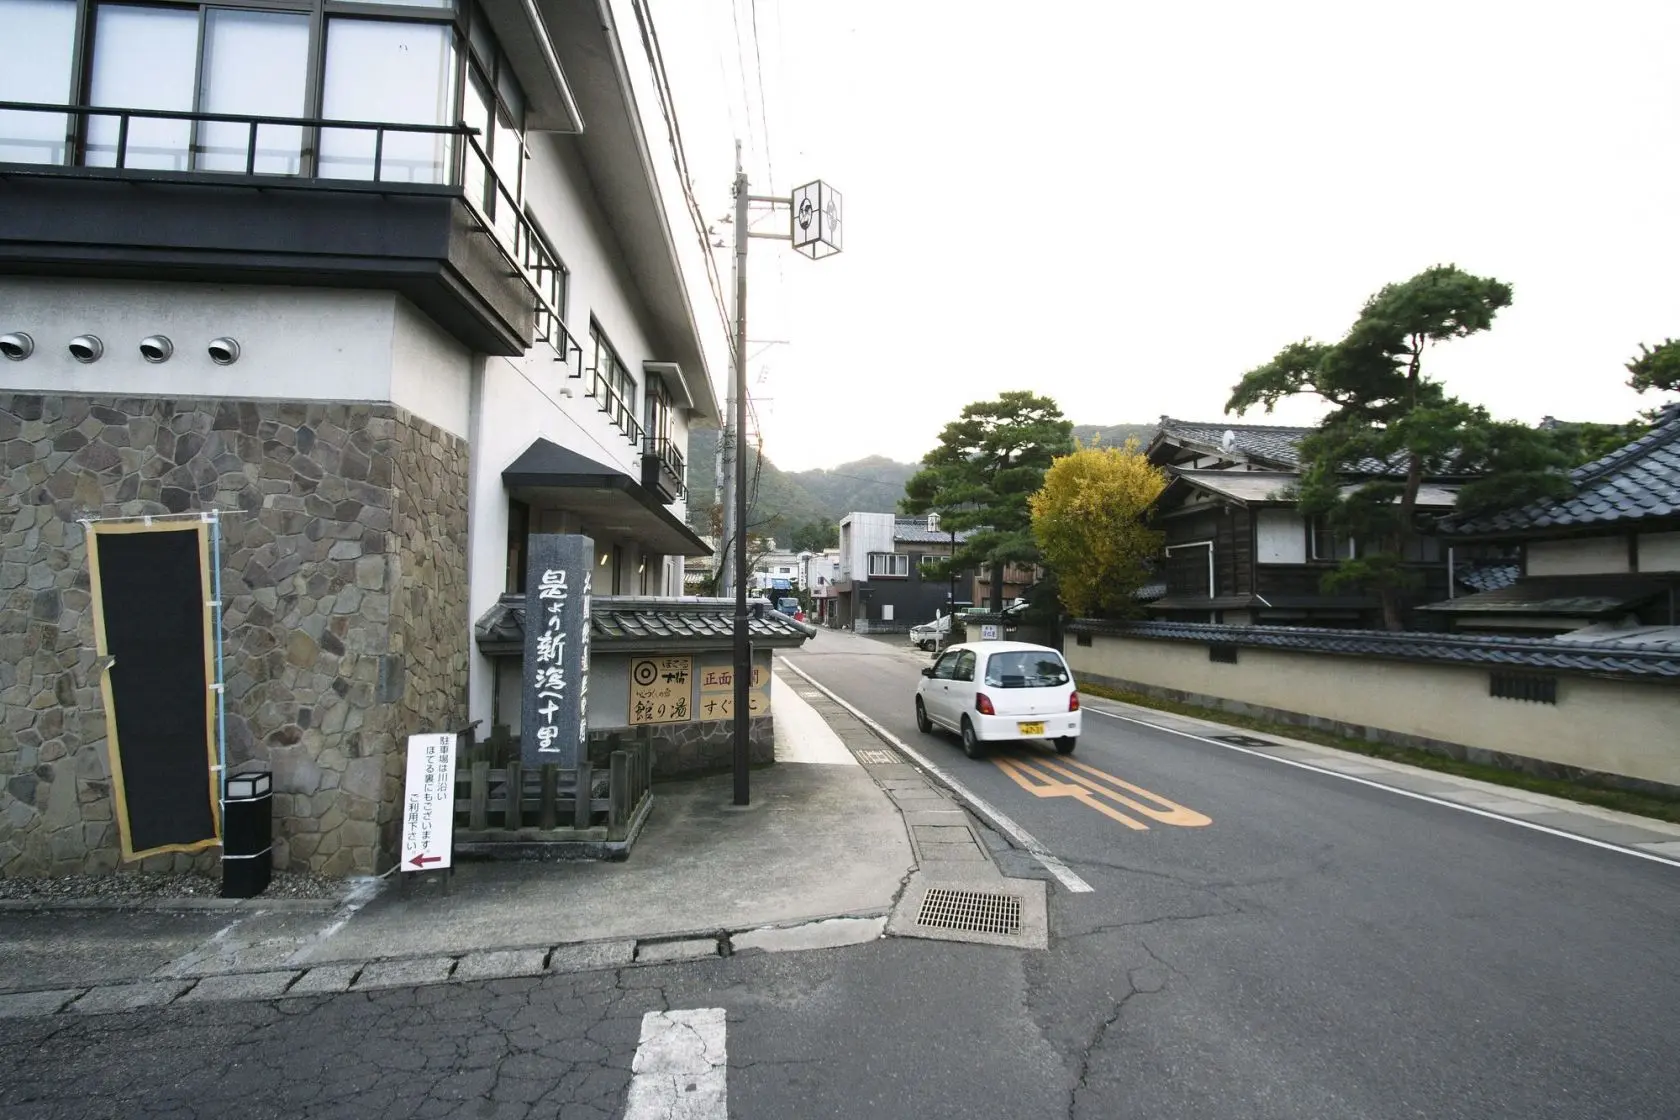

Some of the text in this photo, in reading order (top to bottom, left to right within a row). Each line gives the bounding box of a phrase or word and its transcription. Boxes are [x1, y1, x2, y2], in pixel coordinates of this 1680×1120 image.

[437, 736, 449, 801] 駐車場は川沿い
